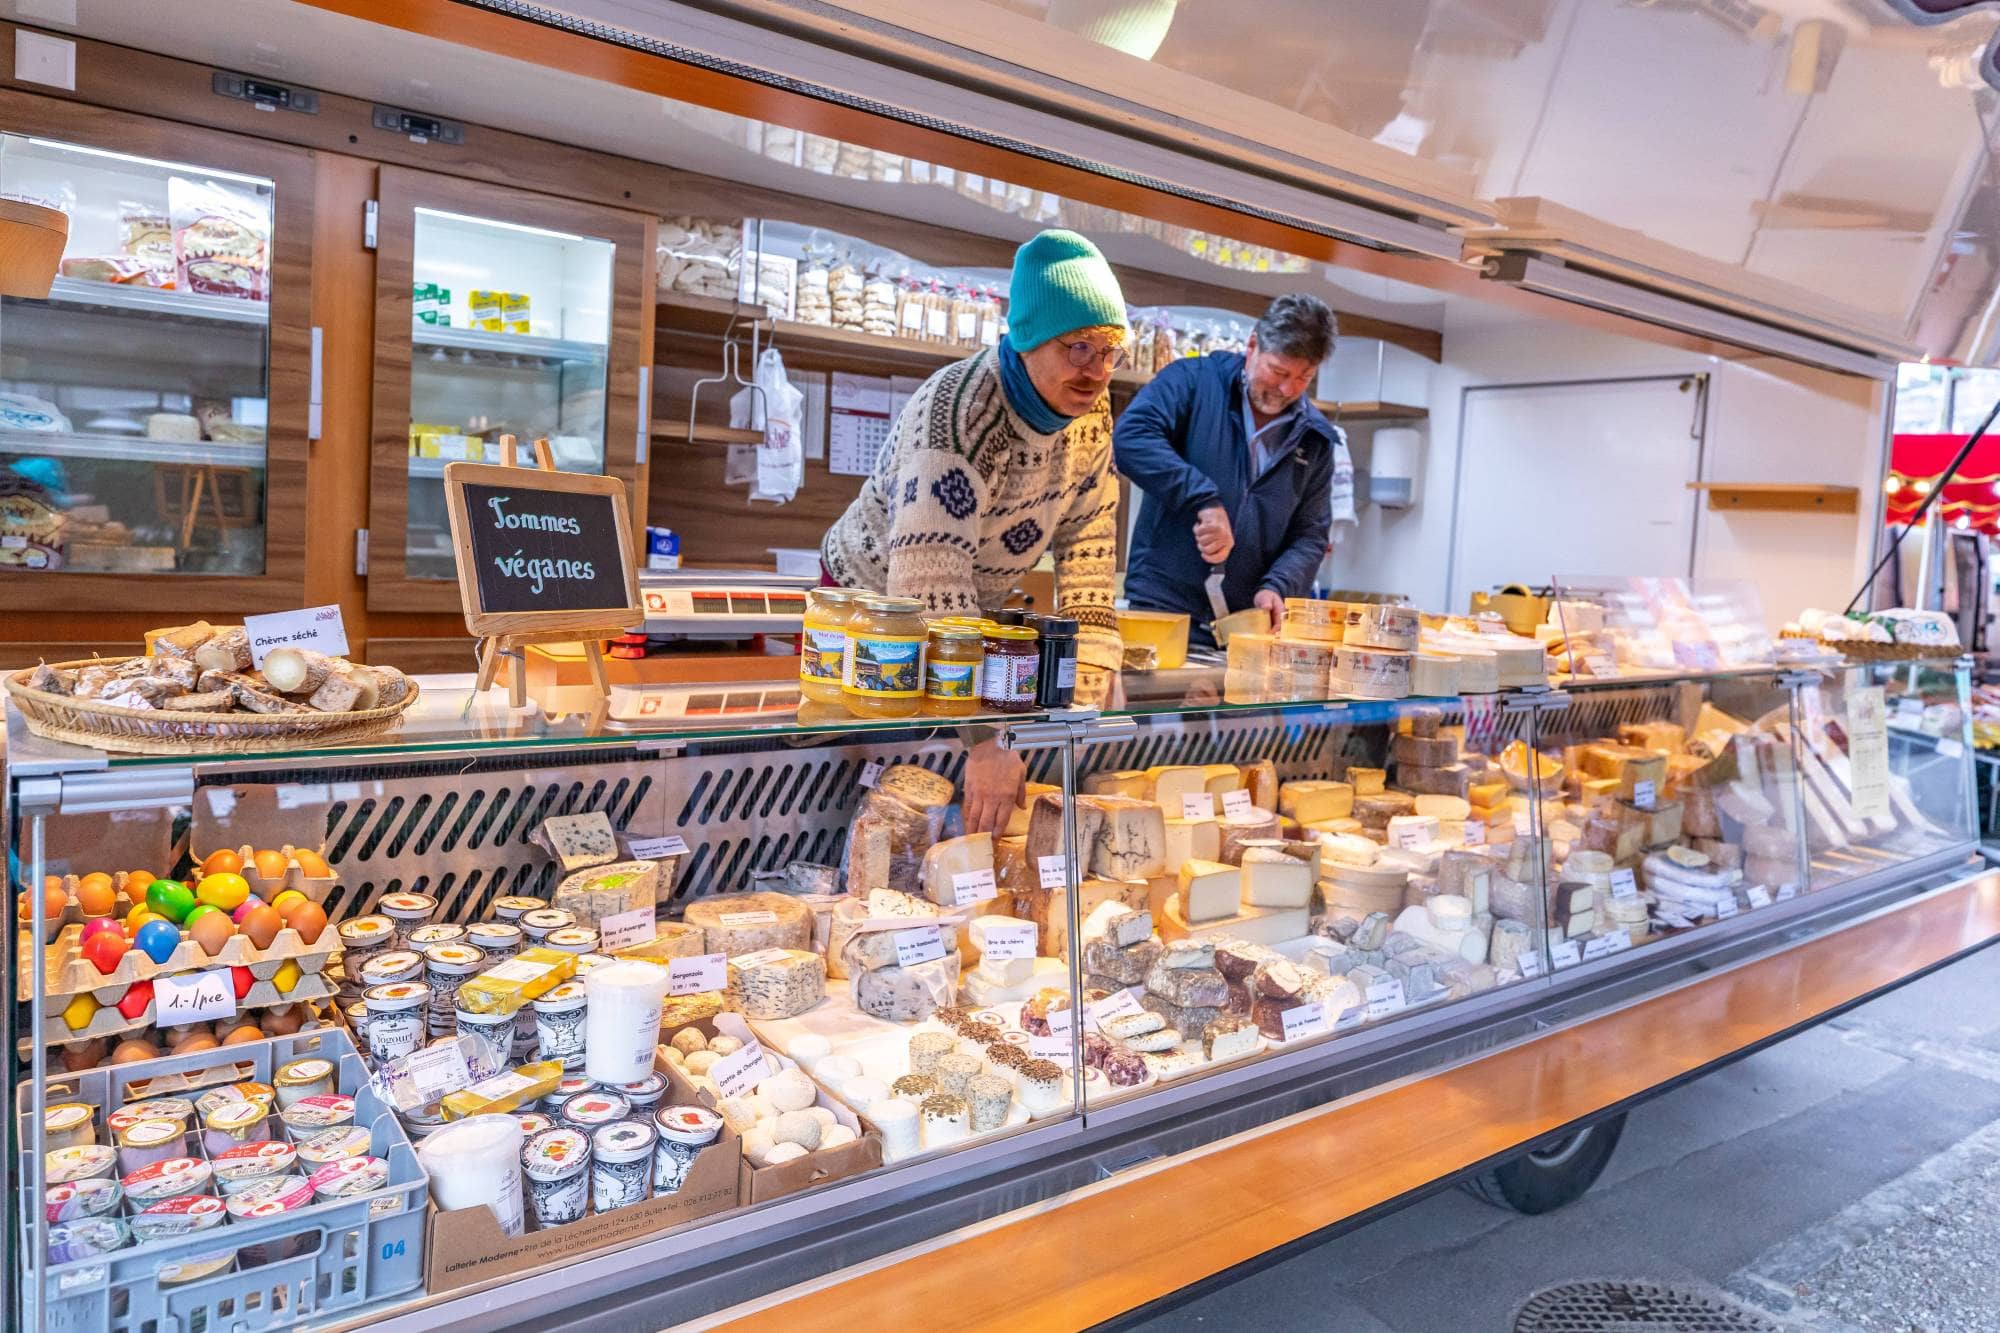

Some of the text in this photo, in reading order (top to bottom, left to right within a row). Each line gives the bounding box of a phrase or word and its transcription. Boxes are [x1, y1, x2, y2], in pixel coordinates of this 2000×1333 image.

[487, 496, 581, 535] Tommes
[494, 549, 596, 594] véganes
[255, 629, 319, 646] Chèvre séché
[672, 970, 704, 980] Gorgonzola
[382, 1239, 405, 1260] 04
[445, 1260, 478, 1273] Laiterie
